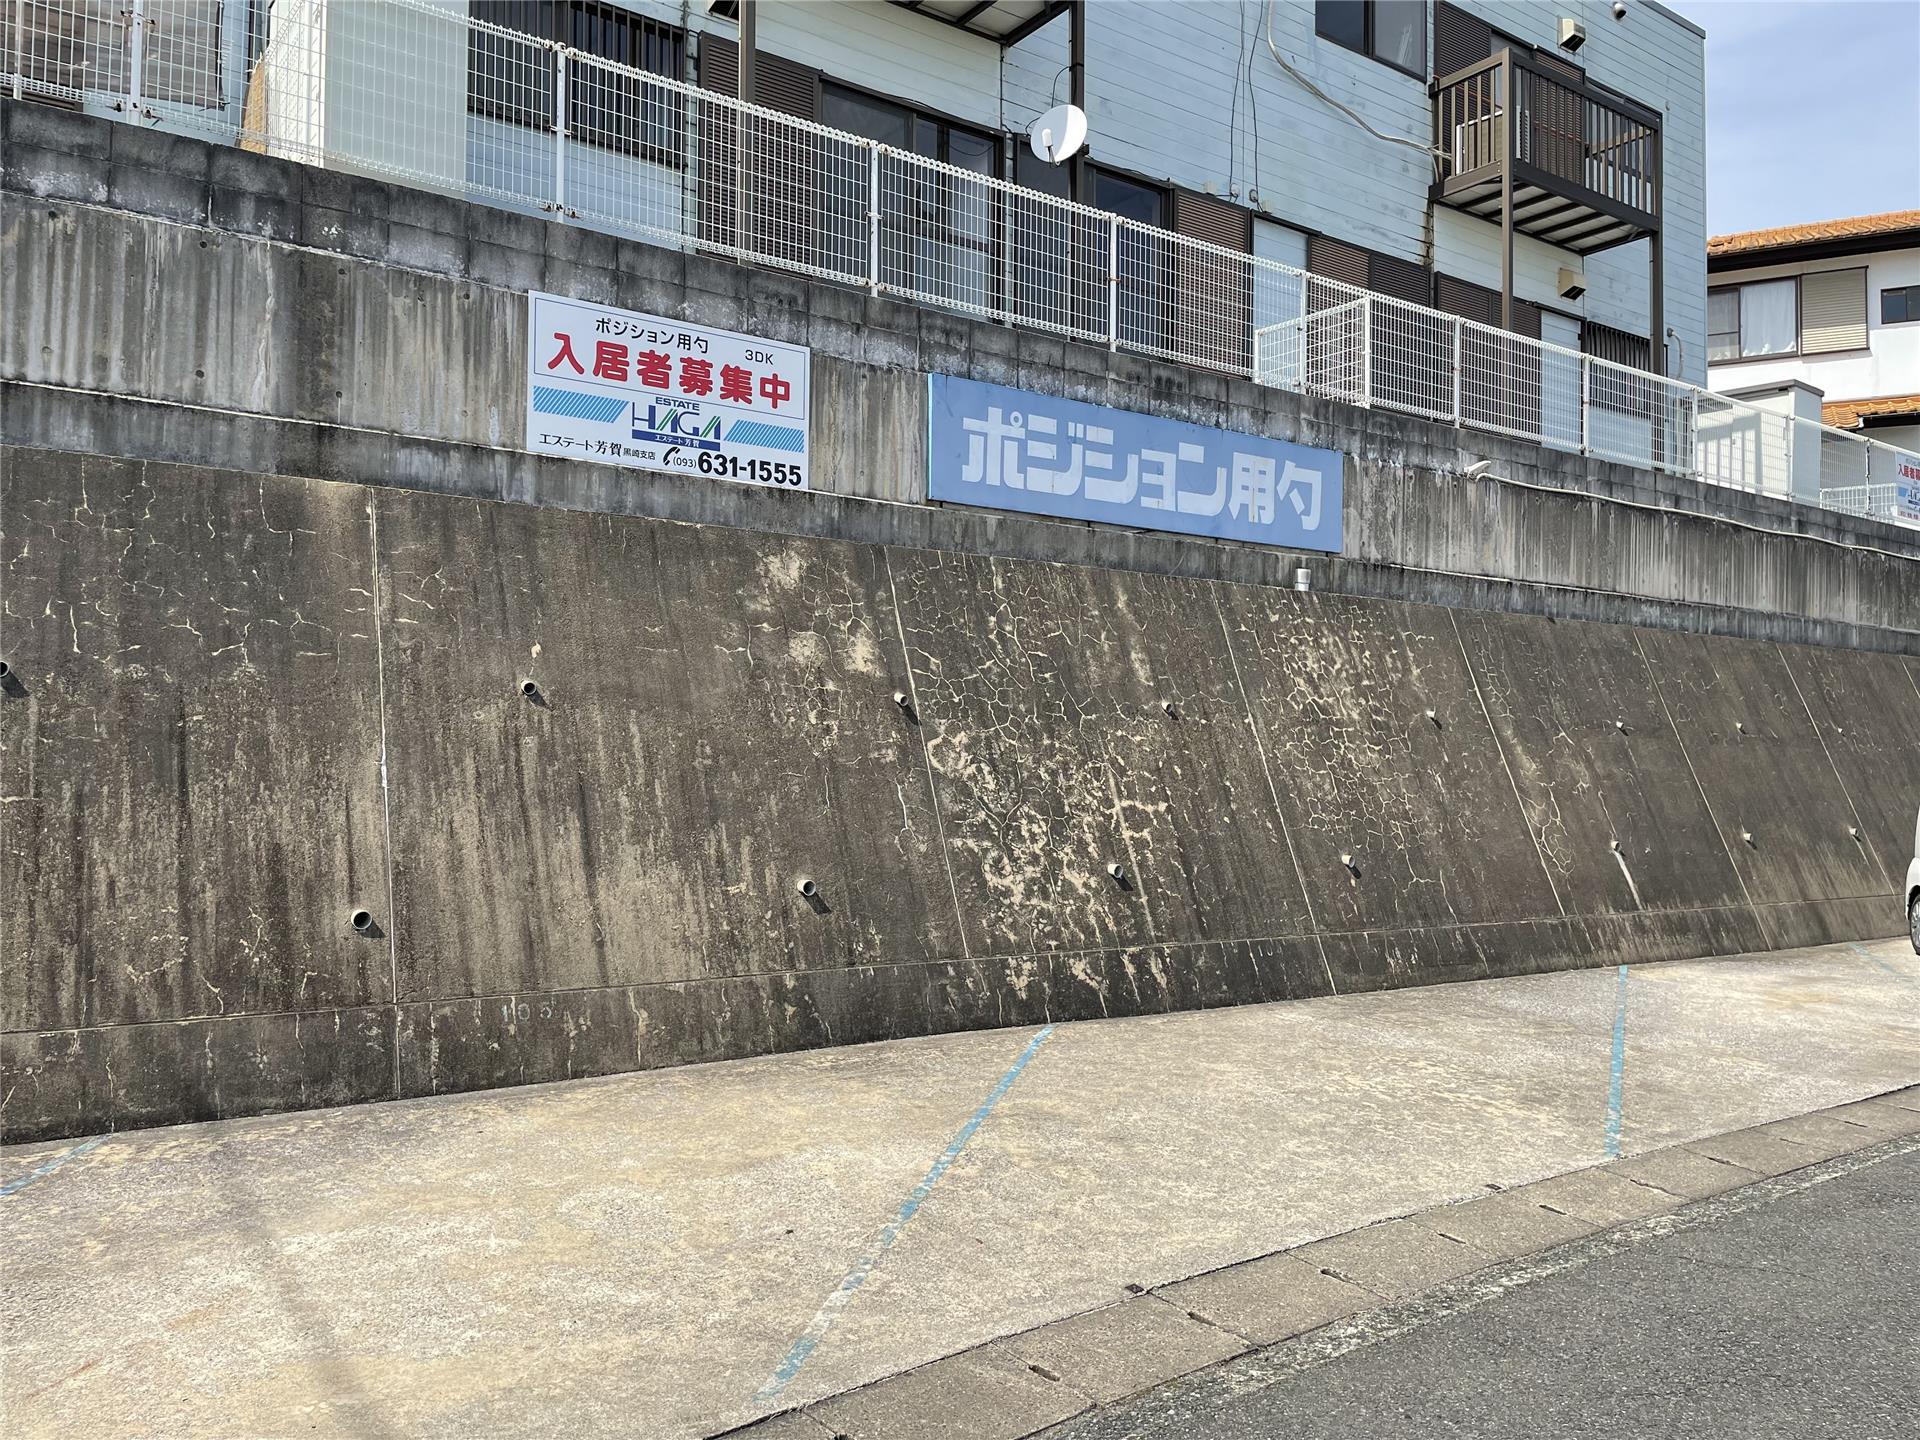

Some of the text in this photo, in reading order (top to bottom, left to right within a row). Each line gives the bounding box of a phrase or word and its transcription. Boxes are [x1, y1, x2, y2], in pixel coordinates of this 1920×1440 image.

[595, 318, 774, 365] ポジション用勺 3DK
[547, 333, 790, 409] 入居者募集中
[631, 402, 721, 440] HAGA
[655, 397, 700, 411] ESTATE
[698, 451, 802, 486] 631-1555
[962, 406, 1322, 531] ポジション用勺
